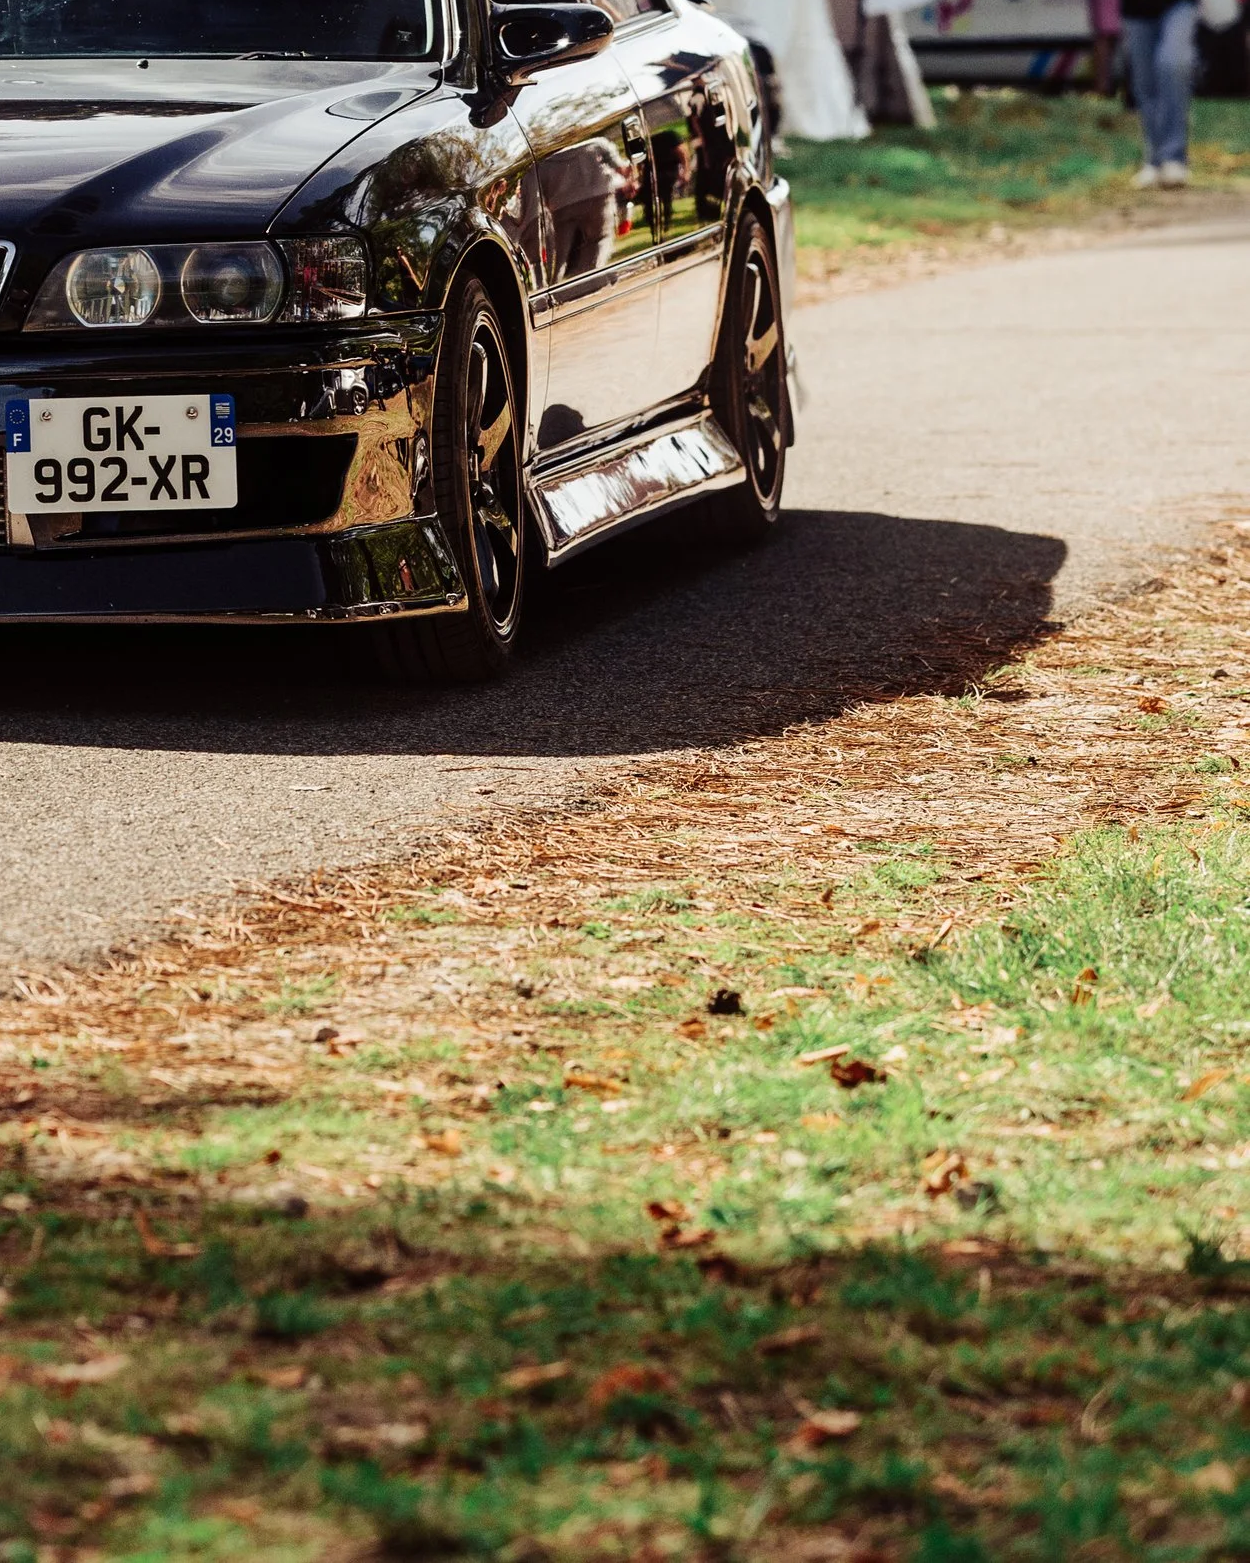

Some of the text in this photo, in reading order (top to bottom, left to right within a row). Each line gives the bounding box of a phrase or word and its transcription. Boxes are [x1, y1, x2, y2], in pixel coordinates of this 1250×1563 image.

[13, 433, 23, 447] F
[82, 405, 161, 452] GK-
[213, 427, 234, 444] 29
[33, 454, 211, 504] 992-XR
